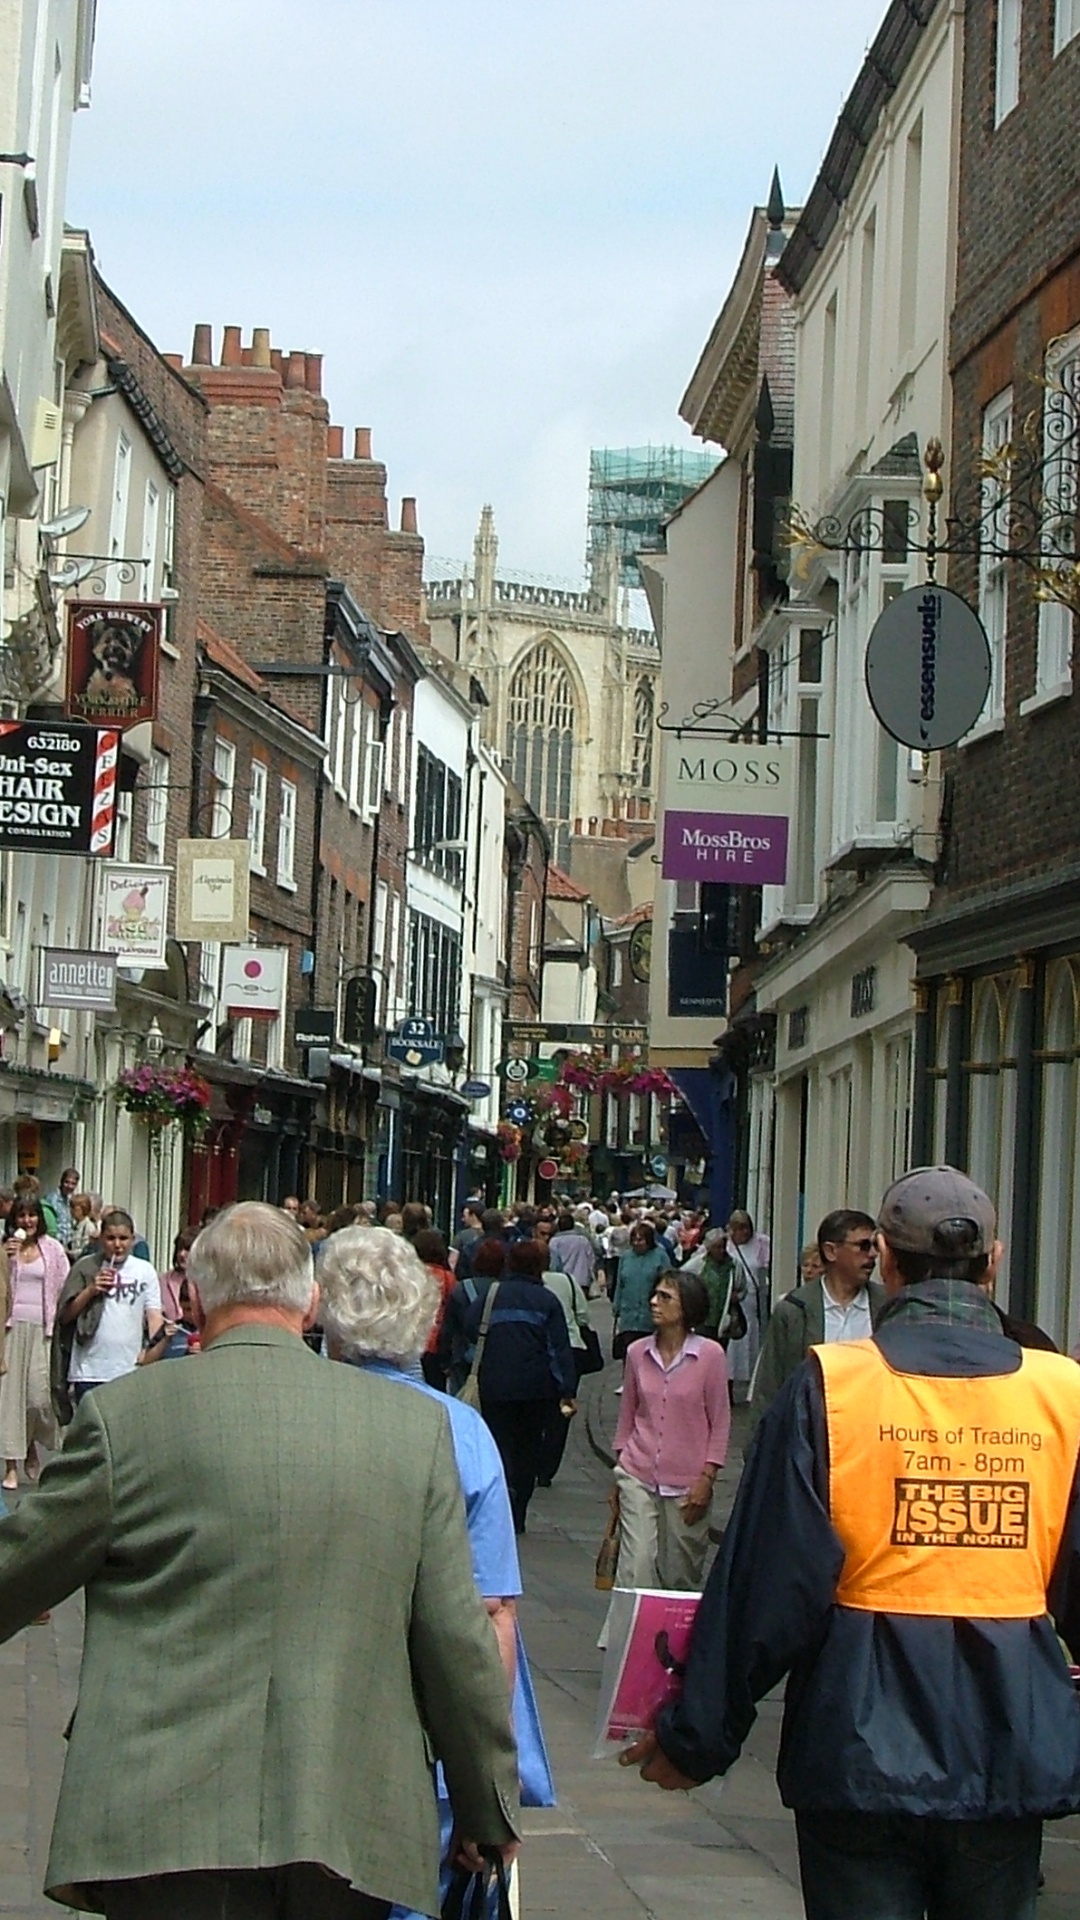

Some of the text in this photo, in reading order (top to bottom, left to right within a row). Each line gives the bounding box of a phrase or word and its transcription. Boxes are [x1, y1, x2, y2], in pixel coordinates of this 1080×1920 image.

[917, 594, 936, 721] essensuals
[27, 736, 81, 752] 632180
[678, 757, 781, 785] MOSS
[0, 776, 64, 801] HAIR
[697, 849, 753, 863] HIRE
[296, 1033, 330, 1042] Rohan
[408, 1022, 425, 1035] 32
[879, 1424, 1042, 1450] Hours of Trading
[904, 1451, 951, 1471] 7am
[974, 1453, 1025, 1477] 8pm
[900, 1484, 1025, 1502] THE BIG
[896, 1501, 1025, 1534] ISSUE
[896, 1533, 1025, 1546] IN THE NORTH
